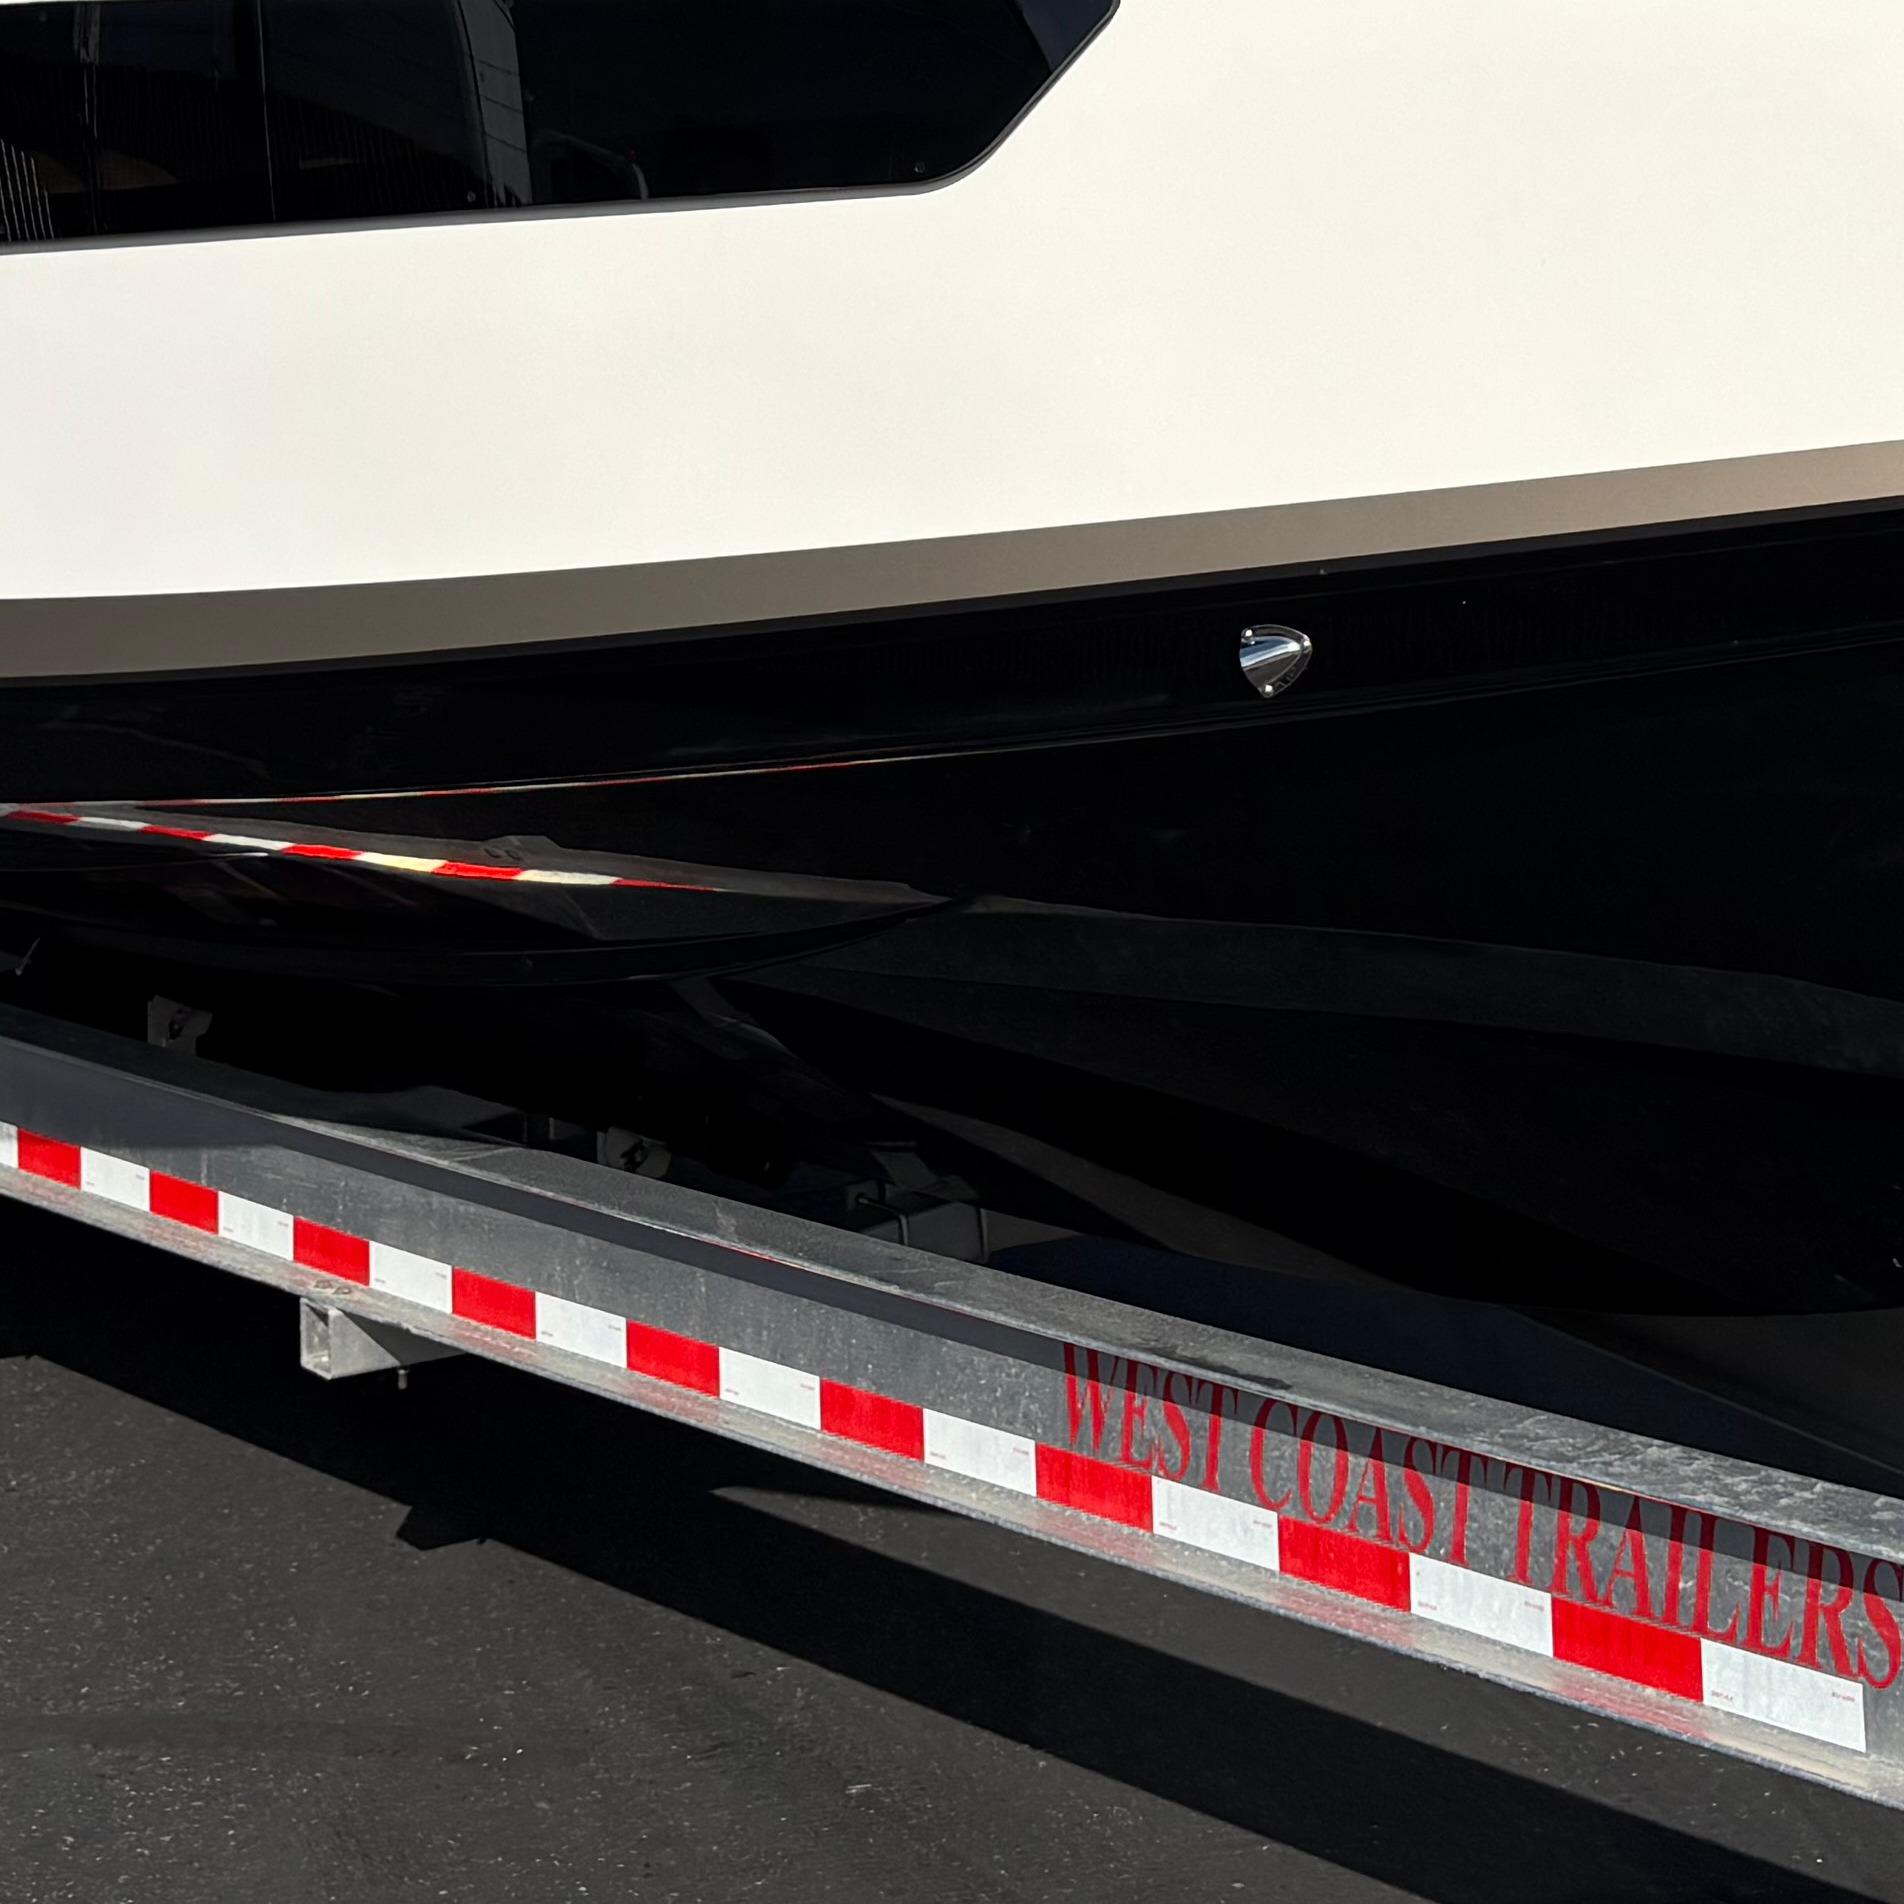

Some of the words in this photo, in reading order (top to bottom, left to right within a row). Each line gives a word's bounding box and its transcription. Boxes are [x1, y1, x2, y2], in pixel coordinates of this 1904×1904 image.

[1064, 1342, 1239, 1494] WEST
[1248, 1396, 1489, 1567] COAST
[1503, 1468, 1904, 1689] TRAILERS
